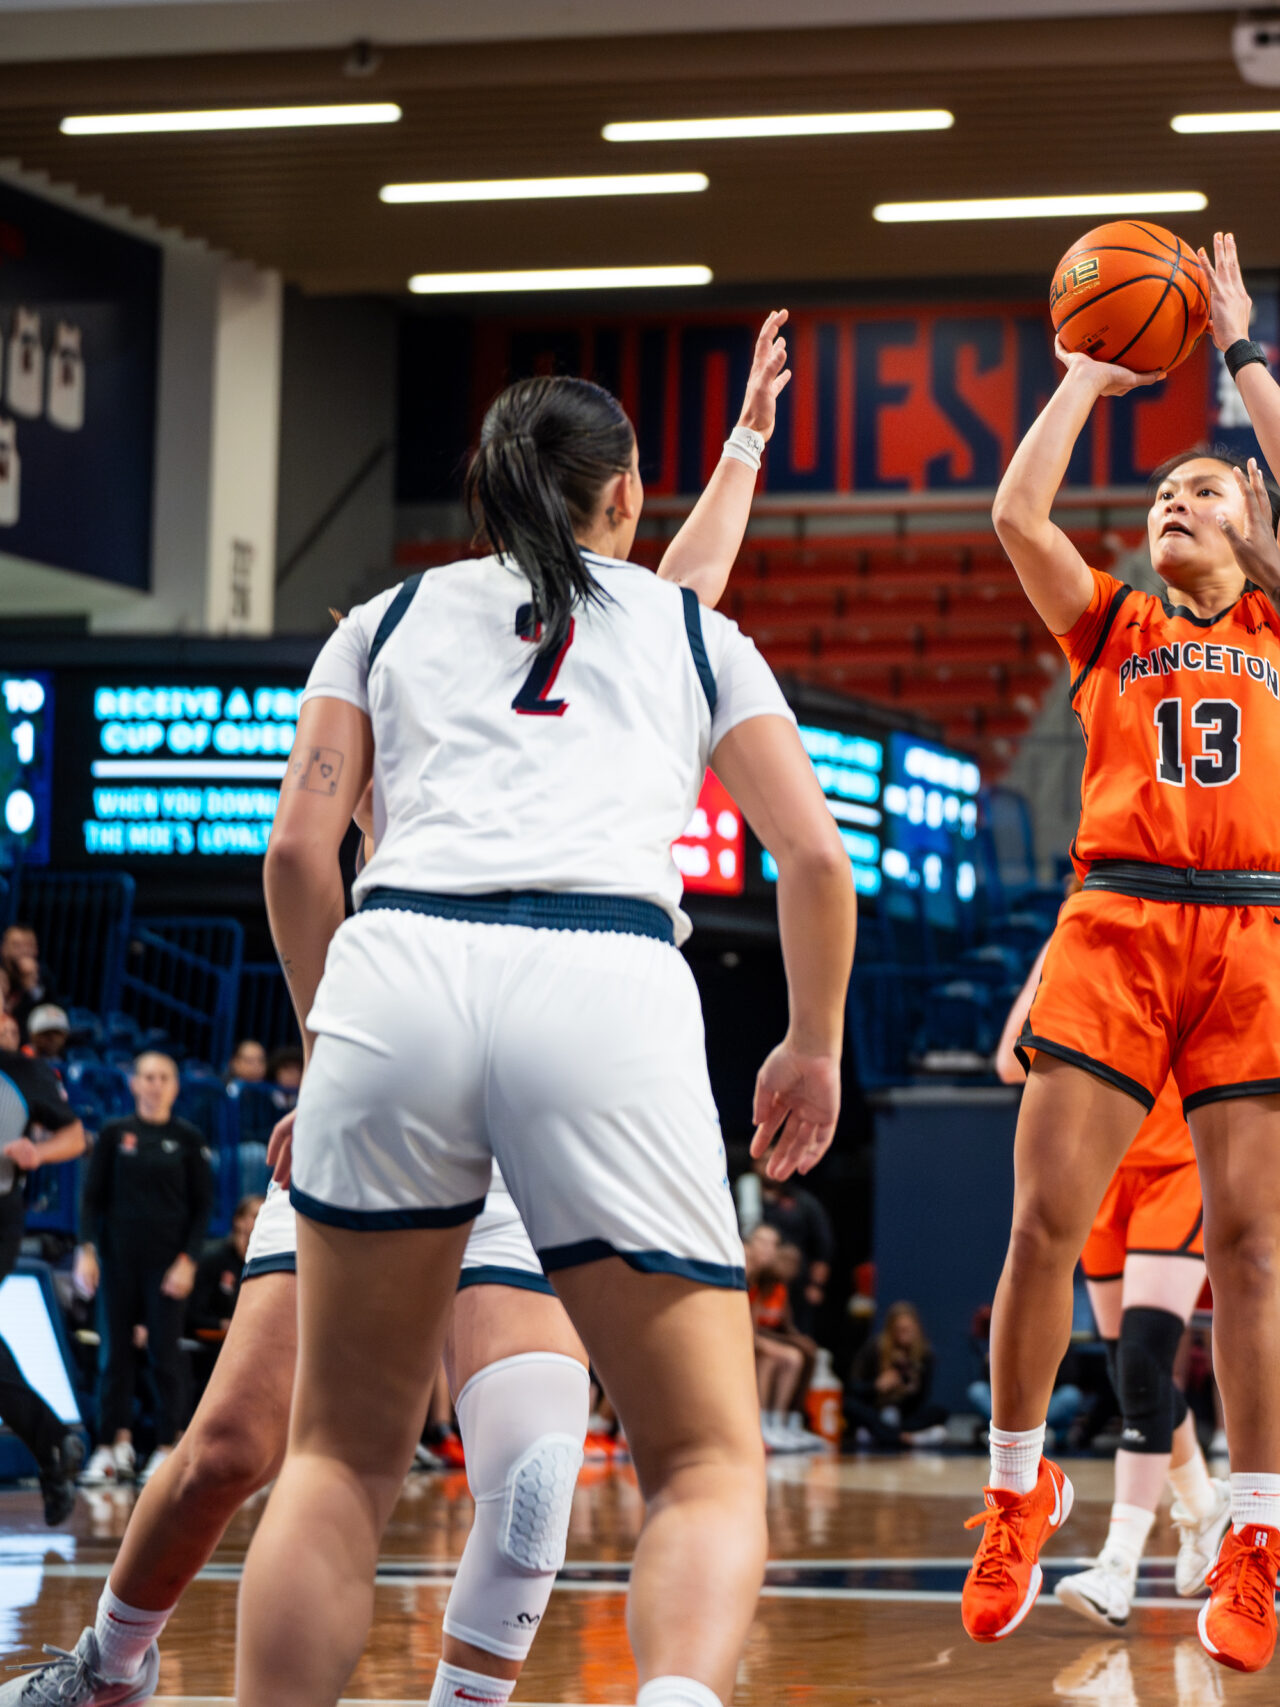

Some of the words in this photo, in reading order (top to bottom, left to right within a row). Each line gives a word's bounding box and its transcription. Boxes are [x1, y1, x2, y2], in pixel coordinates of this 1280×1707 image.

[511, 602, 577, 717] 2
[1119, 641, 1280, 700] PRINCETON
[95, 686, 223, 720] RECEIVE
[224, 687, 252, 720] A
[100, 720, 165, 755] CUP
[166, 721, 213, 754] OF
[1154, 697, 1241, 787] 13
[160, 787, 203, 820] YOU
